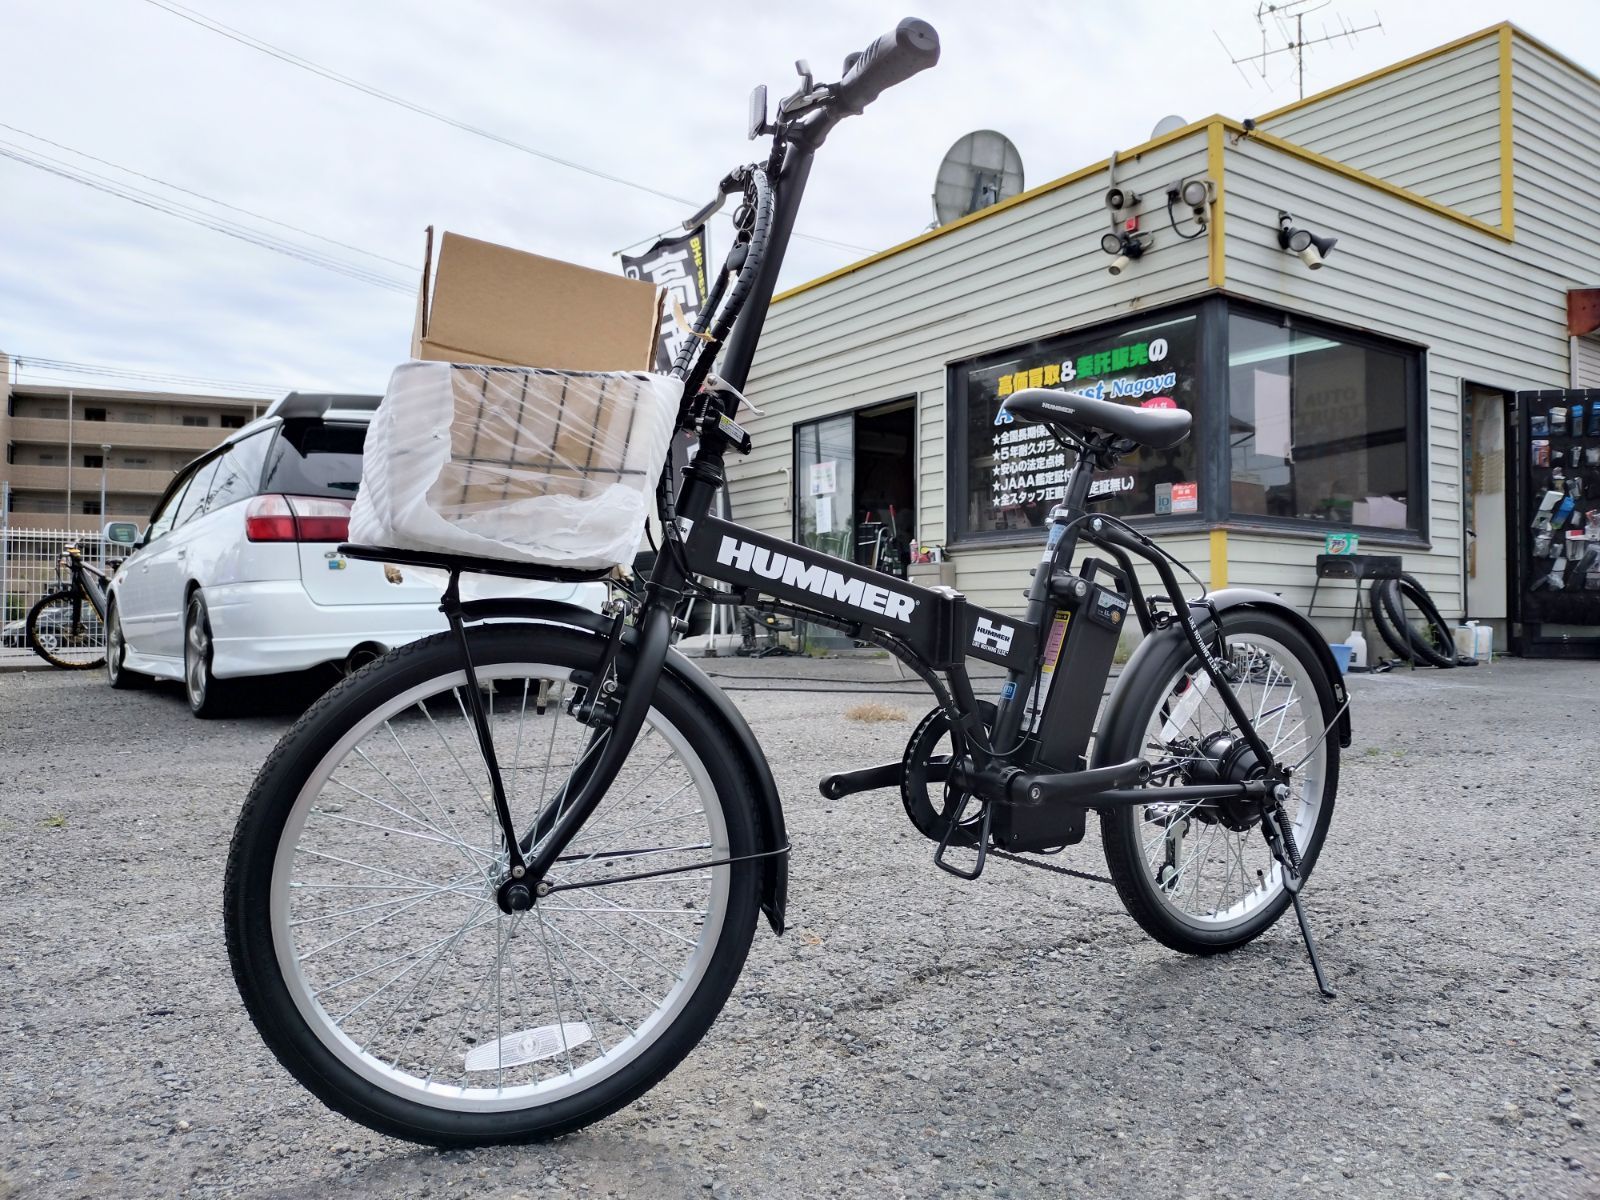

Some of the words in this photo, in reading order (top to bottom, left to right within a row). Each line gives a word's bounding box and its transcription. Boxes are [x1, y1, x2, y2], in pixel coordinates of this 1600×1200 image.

[1110, 372, 1176, 399] Nagoya
[717, 535, 914, 623] HUMMER
[977, 627, 1010, 642] HUMMER
[1187, 615, 1197, 630] LIKE
[1193, 629, 1210, 658] NOTHING
